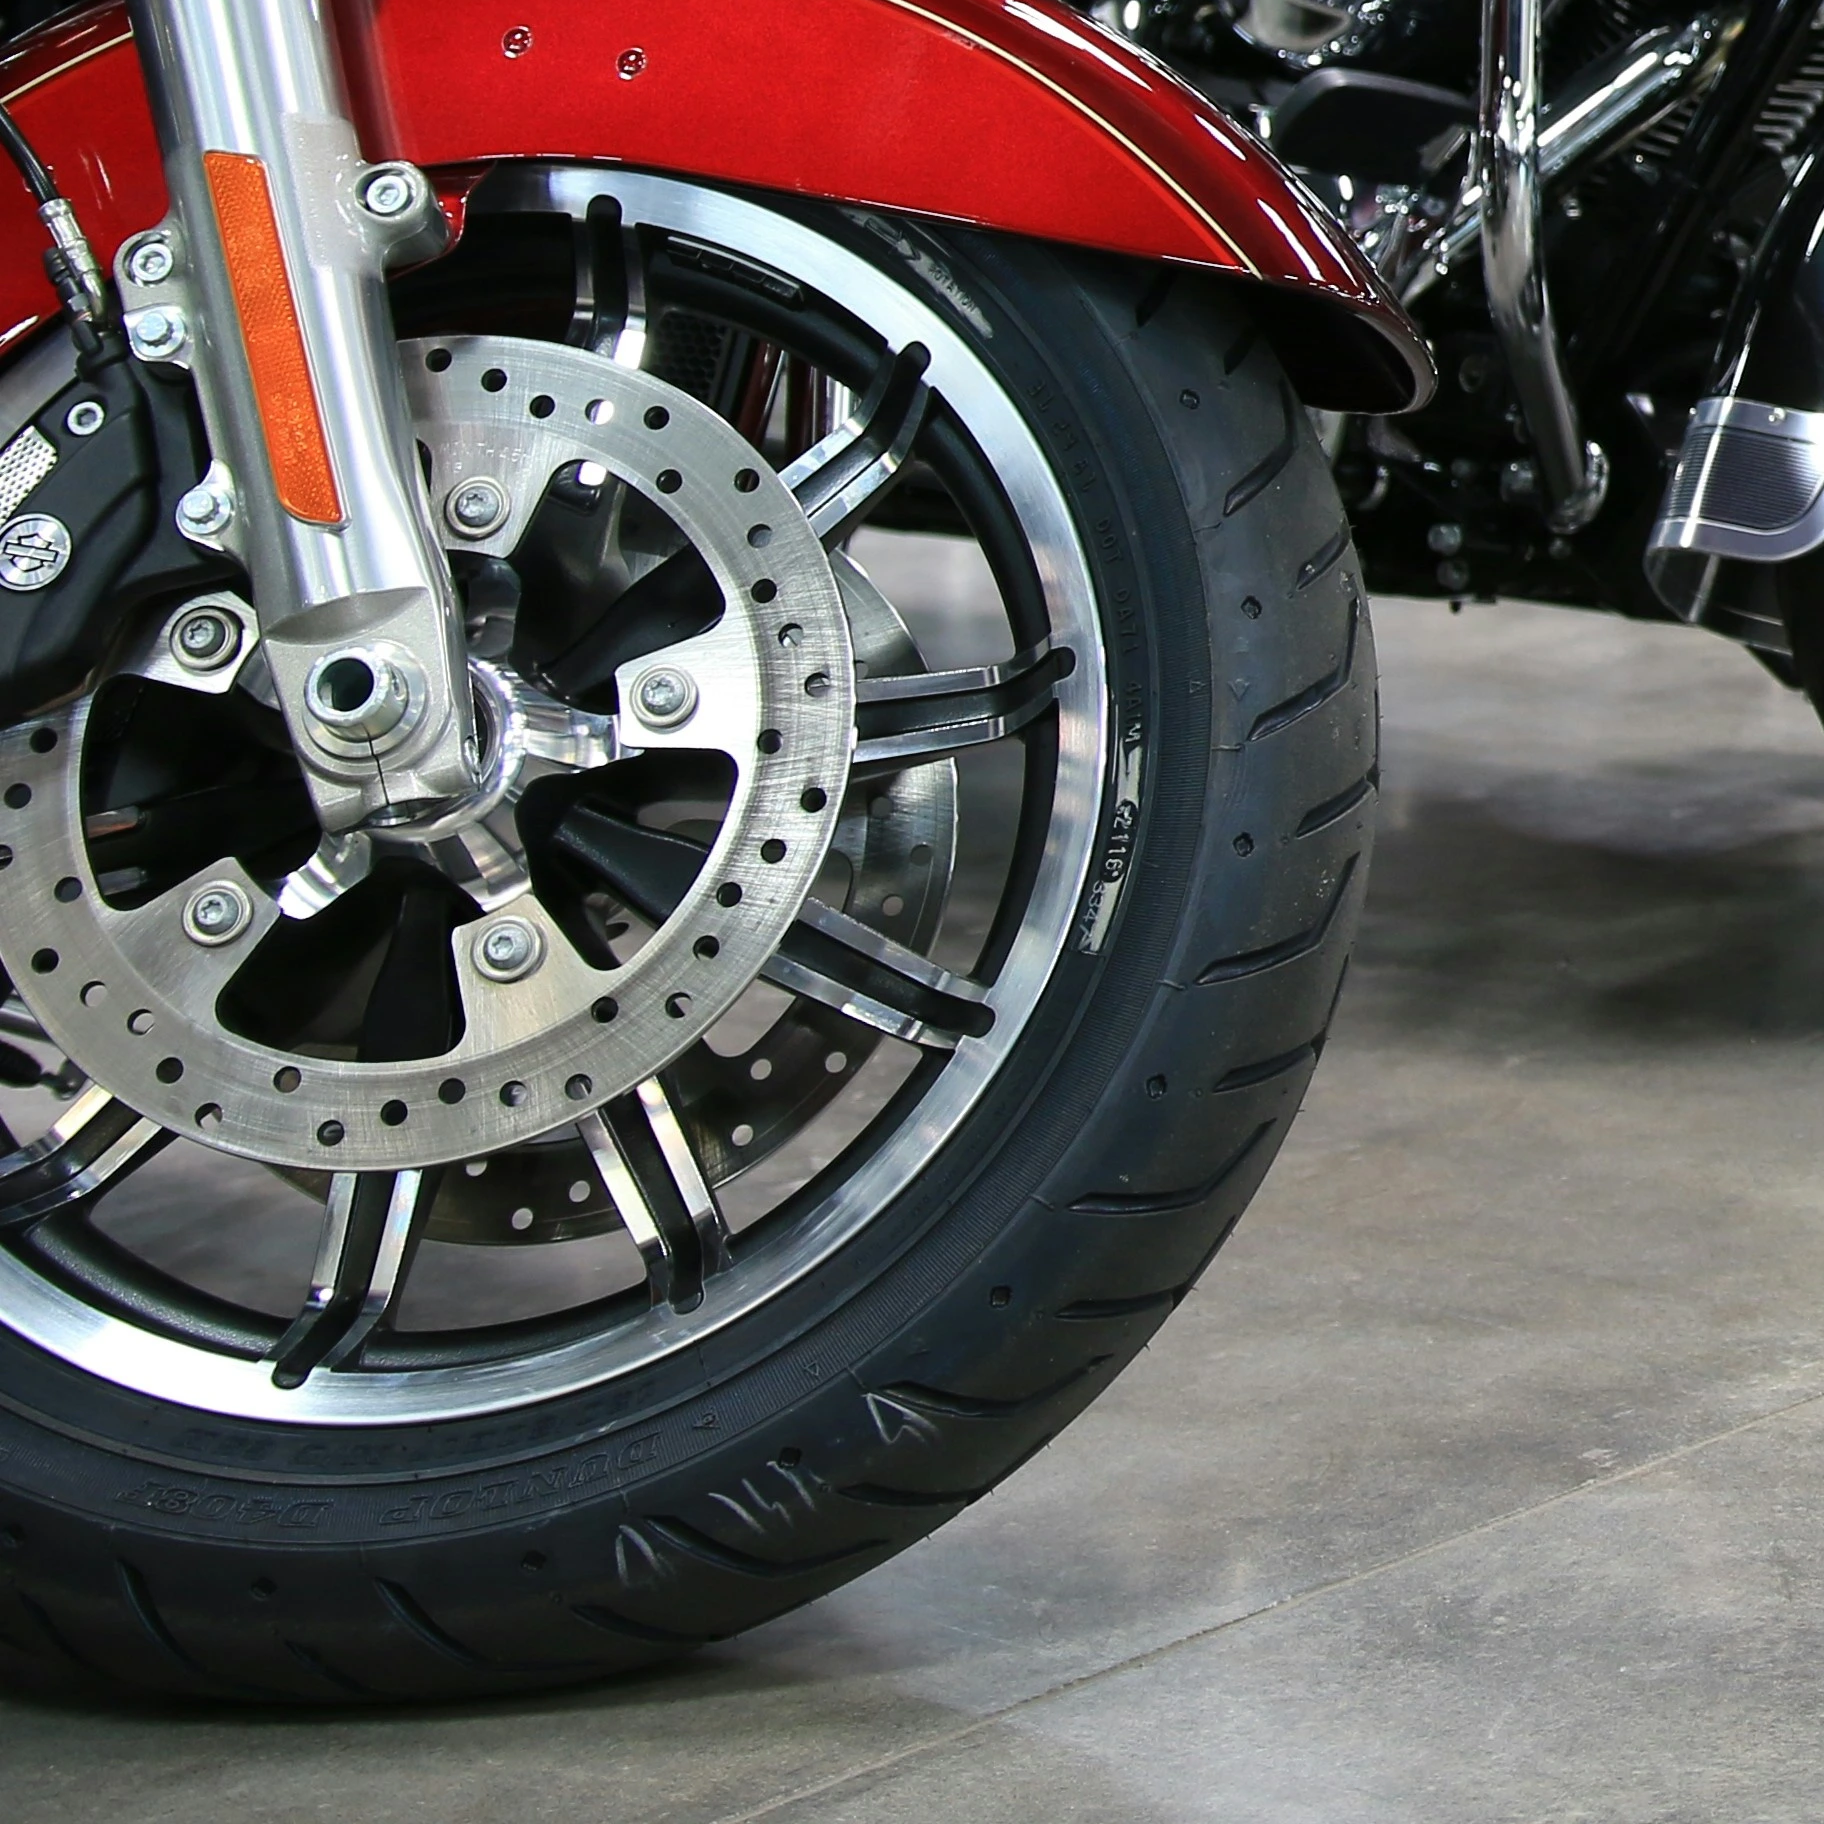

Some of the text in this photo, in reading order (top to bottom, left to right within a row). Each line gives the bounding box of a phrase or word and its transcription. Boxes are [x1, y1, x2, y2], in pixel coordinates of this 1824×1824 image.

[1095, 517, 1122, 565] DOT
[118, 1430, 664, 1528] DUNLOP D408F
